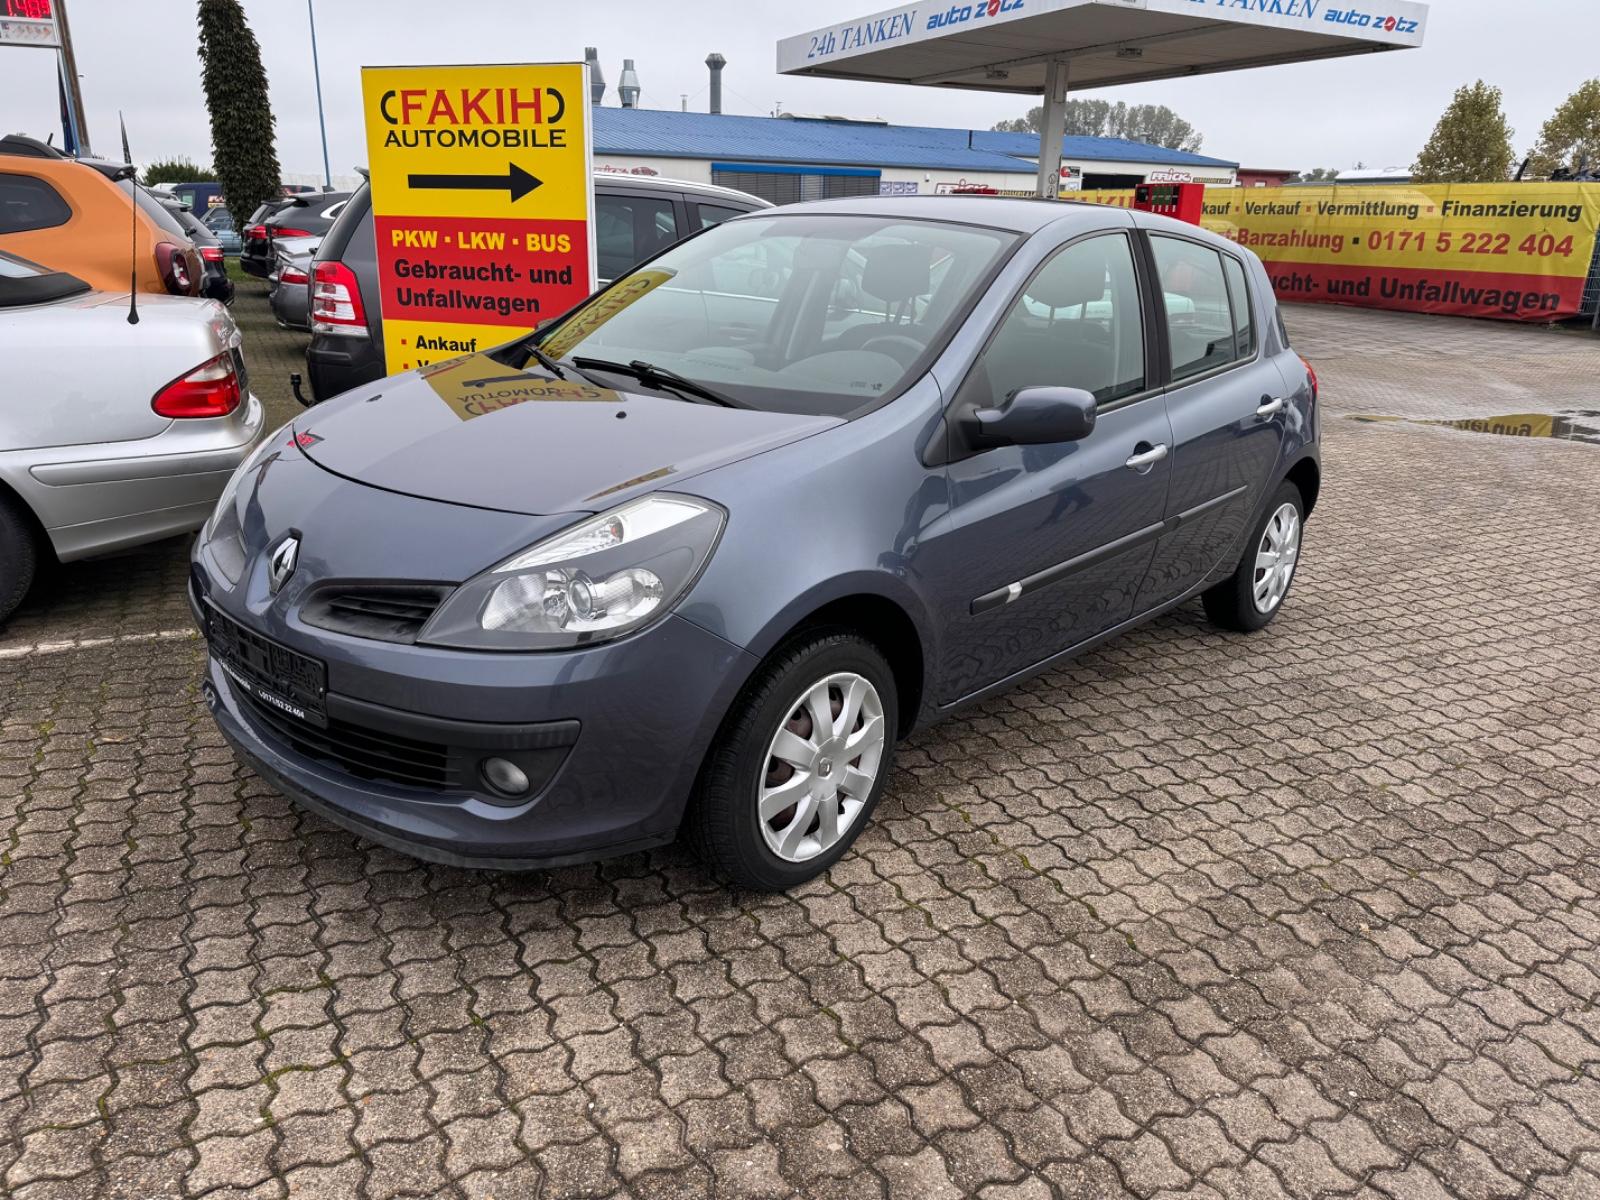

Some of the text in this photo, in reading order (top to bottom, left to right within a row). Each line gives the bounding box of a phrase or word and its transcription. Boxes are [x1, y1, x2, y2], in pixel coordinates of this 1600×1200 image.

[926, 6, 972, 30] auto
[1324, 9, 1370, 27] auto
[808, 10, 916, 58] 24h TANKEN
[384, 129, 567, 148] AUTOMOBILE
[1201, 201, 1582, 222] kauf Verkauf Vermittlung Finanzierung
[391, 229, 571, 253] PKW LKW BUS
[1217, 228, 1574, 257] t-Barzahlung 0171 5 222 404
[394, 258, 573, 285] Gebraucht- und
[397, 287, 540, 316] Unfallwagen
[1327, 276, 1370, 298] und
[1380, 278, 1561, 313] Unfallwagen
[416, 335, 477, 353] Ankauf
